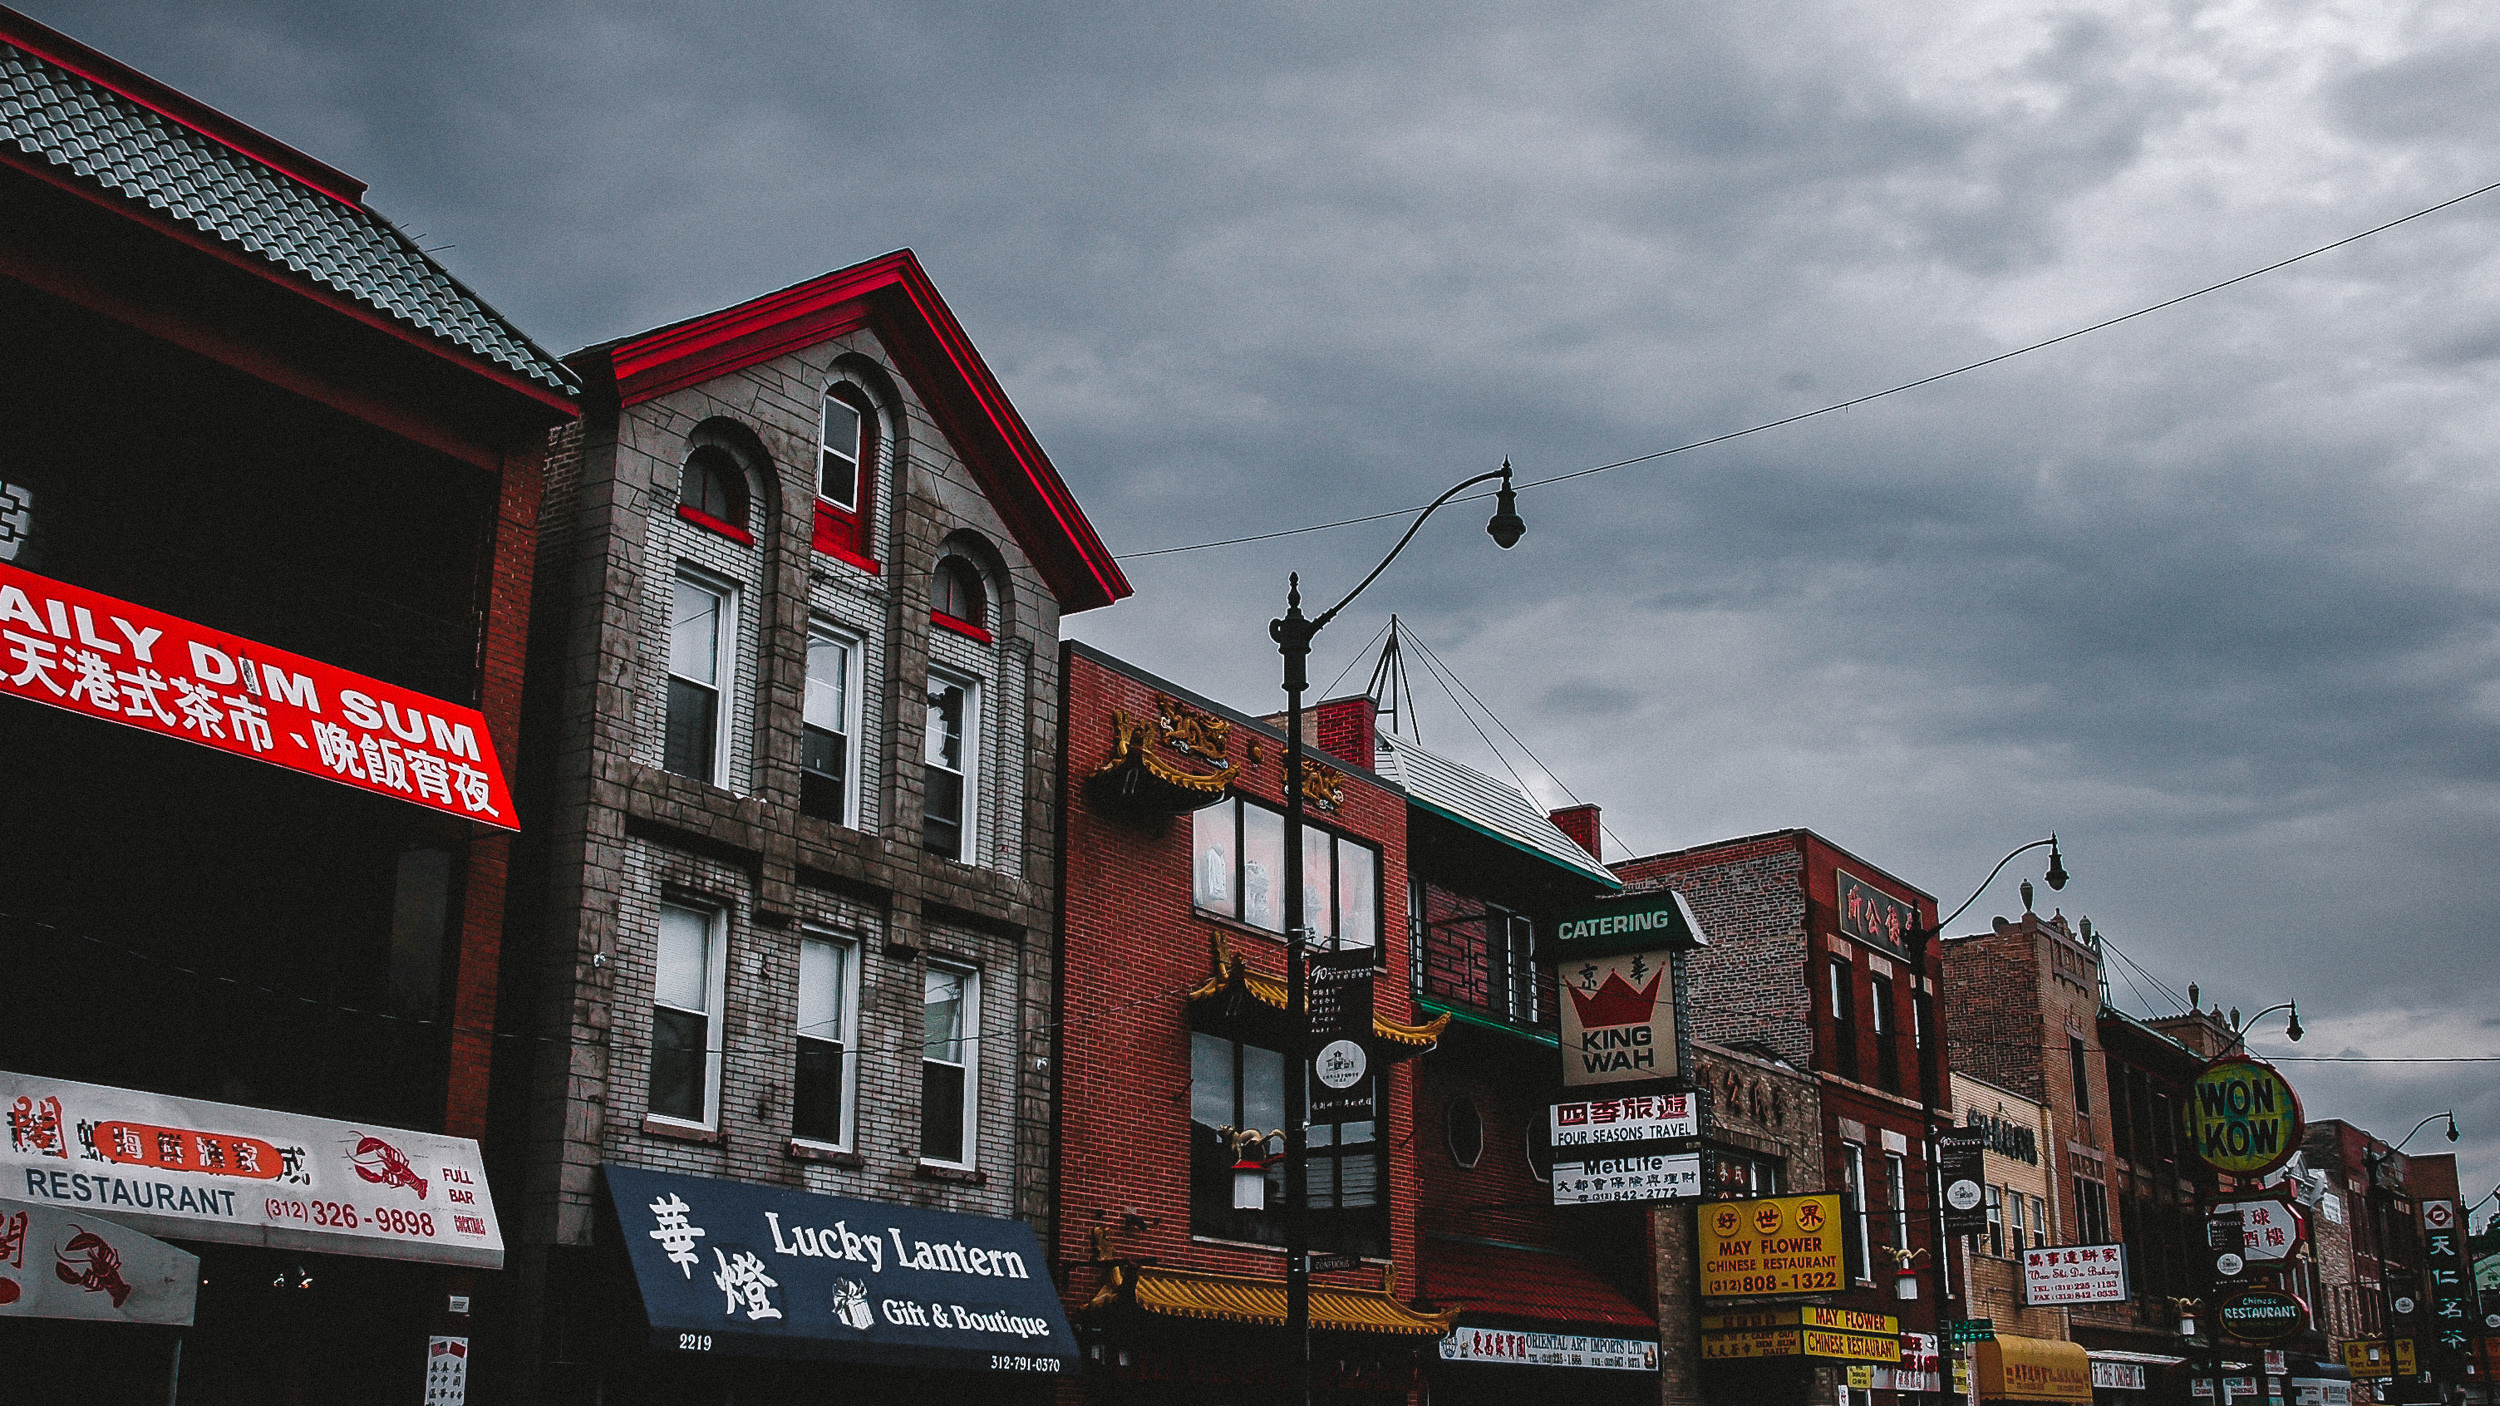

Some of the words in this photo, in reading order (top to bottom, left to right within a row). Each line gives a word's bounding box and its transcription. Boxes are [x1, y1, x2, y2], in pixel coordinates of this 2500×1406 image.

[188, 641, 321, 713] DIM
[340, 690, 481, 762] SUM
[0, 629, 499, 817] 天港式茶市、晚飯宵夜
[1558, 910, 1669, 940] CATERING
[1581, 1025, 1652, 1054] KING
[1582, 1048, 1654, 1074] WAH
[1558, 1094, 1690, 1126] 四季旅遊
[2202, 1078, 2275, 1117] WON
[1558, 1132, 1587, 1146] FOUR
[1593, 1126, 1643, 1142] SEASONS
[1649, 1123, 1691, 1138] TRAVEL
[2204, 1119, 2279, 1158] KOW
[442, 1168, 474, 1185] FULL
[1583, 1157, 1663, 1176] MetLife
[26, 1169, 235, 1216] RESTAURANT
[449, 1189, 475, 1205] BAR
[1716, 1205, 1824, 1229] 好世界
[765, 1212, 882, 1273] Lucky
[888, 1228, 1030, 1279] Lantern
[1719, 1241, 1752, 1256] MAY
[1761, 1237, 1822, 1254] FLOWER
[1707, 1260, 1756, 1273] CHINESE
[1763, 1256, 1836, 1270] RESTAURANT
[882, 1300, 930, 1328] Gift
[933, 1304, 953, 1329] &
[950, 1305, 1050, 1339] Boutique
[1816, 1308, 1839, 1325] MAY
[1845, 1314, 1886, 1331] FLOWER
[2224, 1305, 2297, 1319] RESTAURANT
[680, 1334, 712, 1350] 2219
[1526, 1333, 1567, 1350] ORIENTAL
[1571, 1337, 1587, 1351] ART
[1590, 1339, 1624, 1354] IMPORTS
[1808, 1332, 1844, 1354] CHINESE
[1847, 1336, 1896, 1359] RESTAURANT
[991, 1355, 1060, 1372] 312-791-0370
